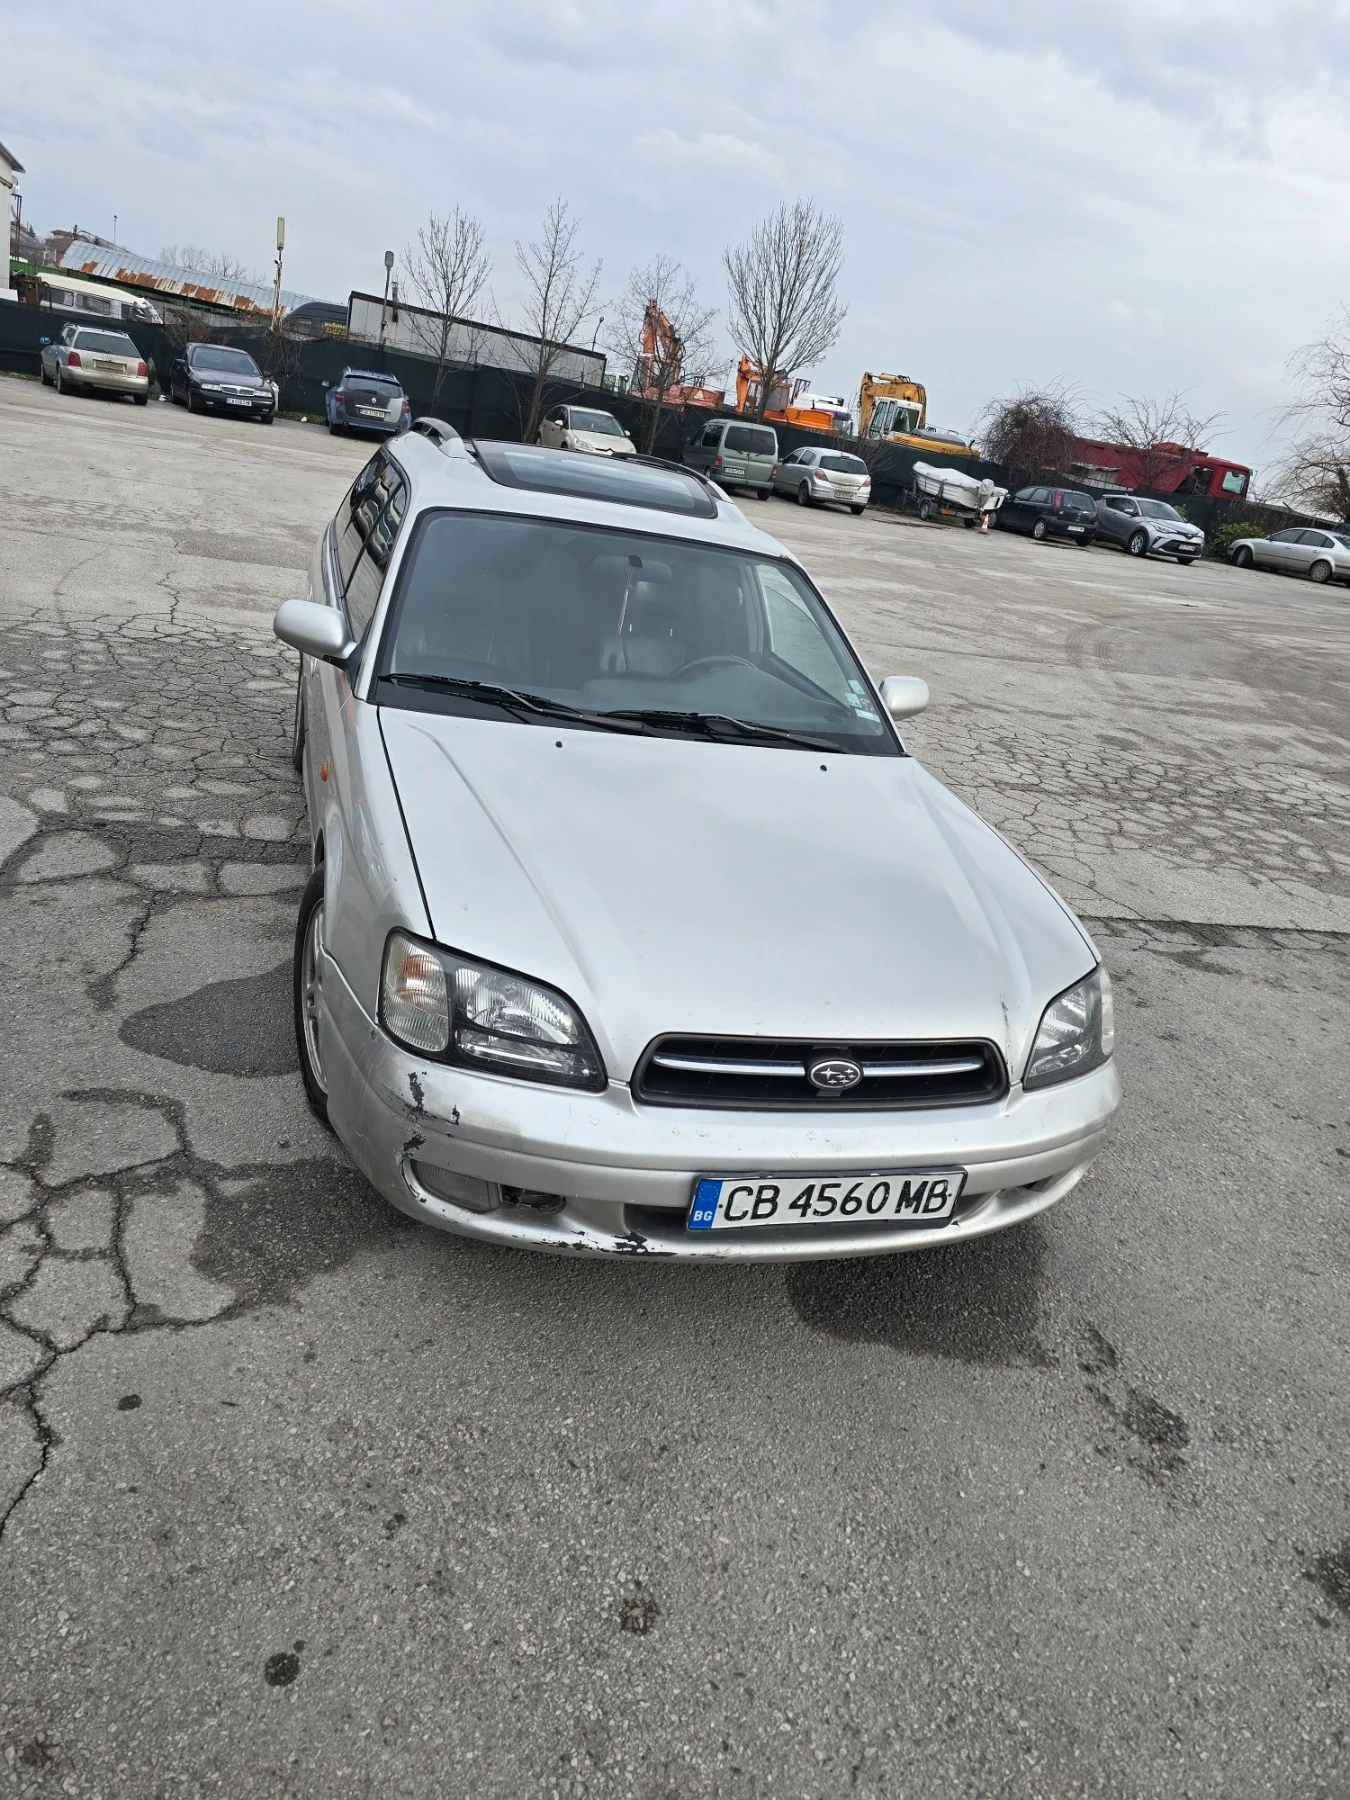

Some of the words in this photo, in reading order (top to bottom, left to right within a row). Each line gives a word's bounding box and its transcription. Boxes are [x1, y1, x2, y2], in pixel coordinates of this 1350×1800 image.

[724, 1185, 780, 1222] CB
[788, 1181, 891, 1218] 4560
[895, 1179, 949, 1214] MB
[693, 1210, 712, 1222] BG
